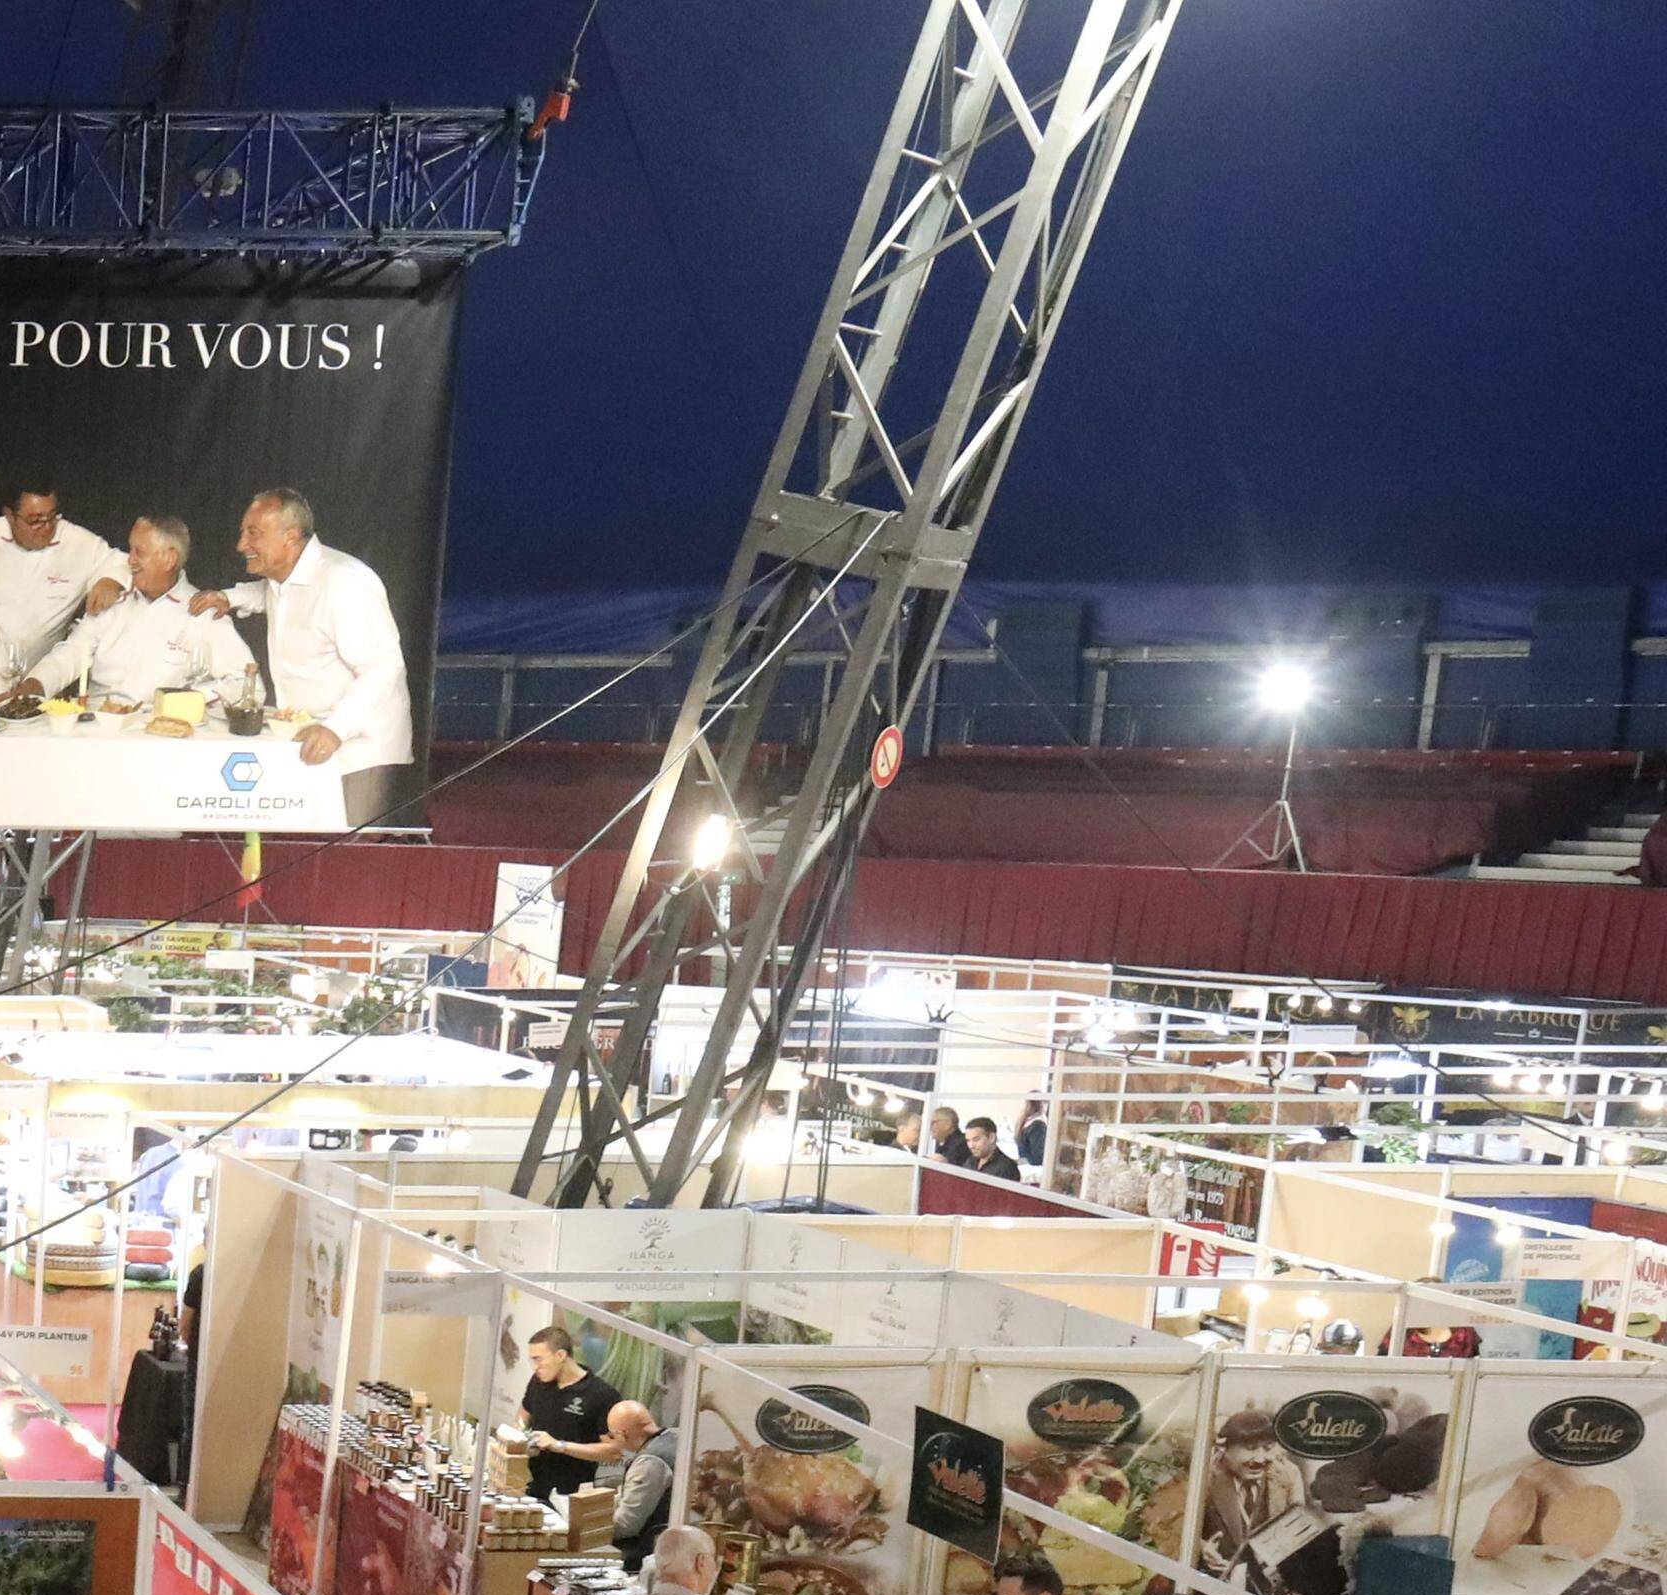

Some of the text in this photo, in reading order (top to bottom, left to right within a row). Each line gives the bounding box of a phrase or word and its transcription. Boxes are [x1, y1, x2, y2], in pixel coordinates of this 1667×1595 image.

[10, 320, 175, 368] POUR
[190, 322, 351, 371] VOUS
[177, 797, 250, 809] CAROLI
[629, 1250, 675, 1259] ILANGA
[16, 1331, 35, 1340] PUR
[38, 1331, 88, 1342] PLANTEUR
